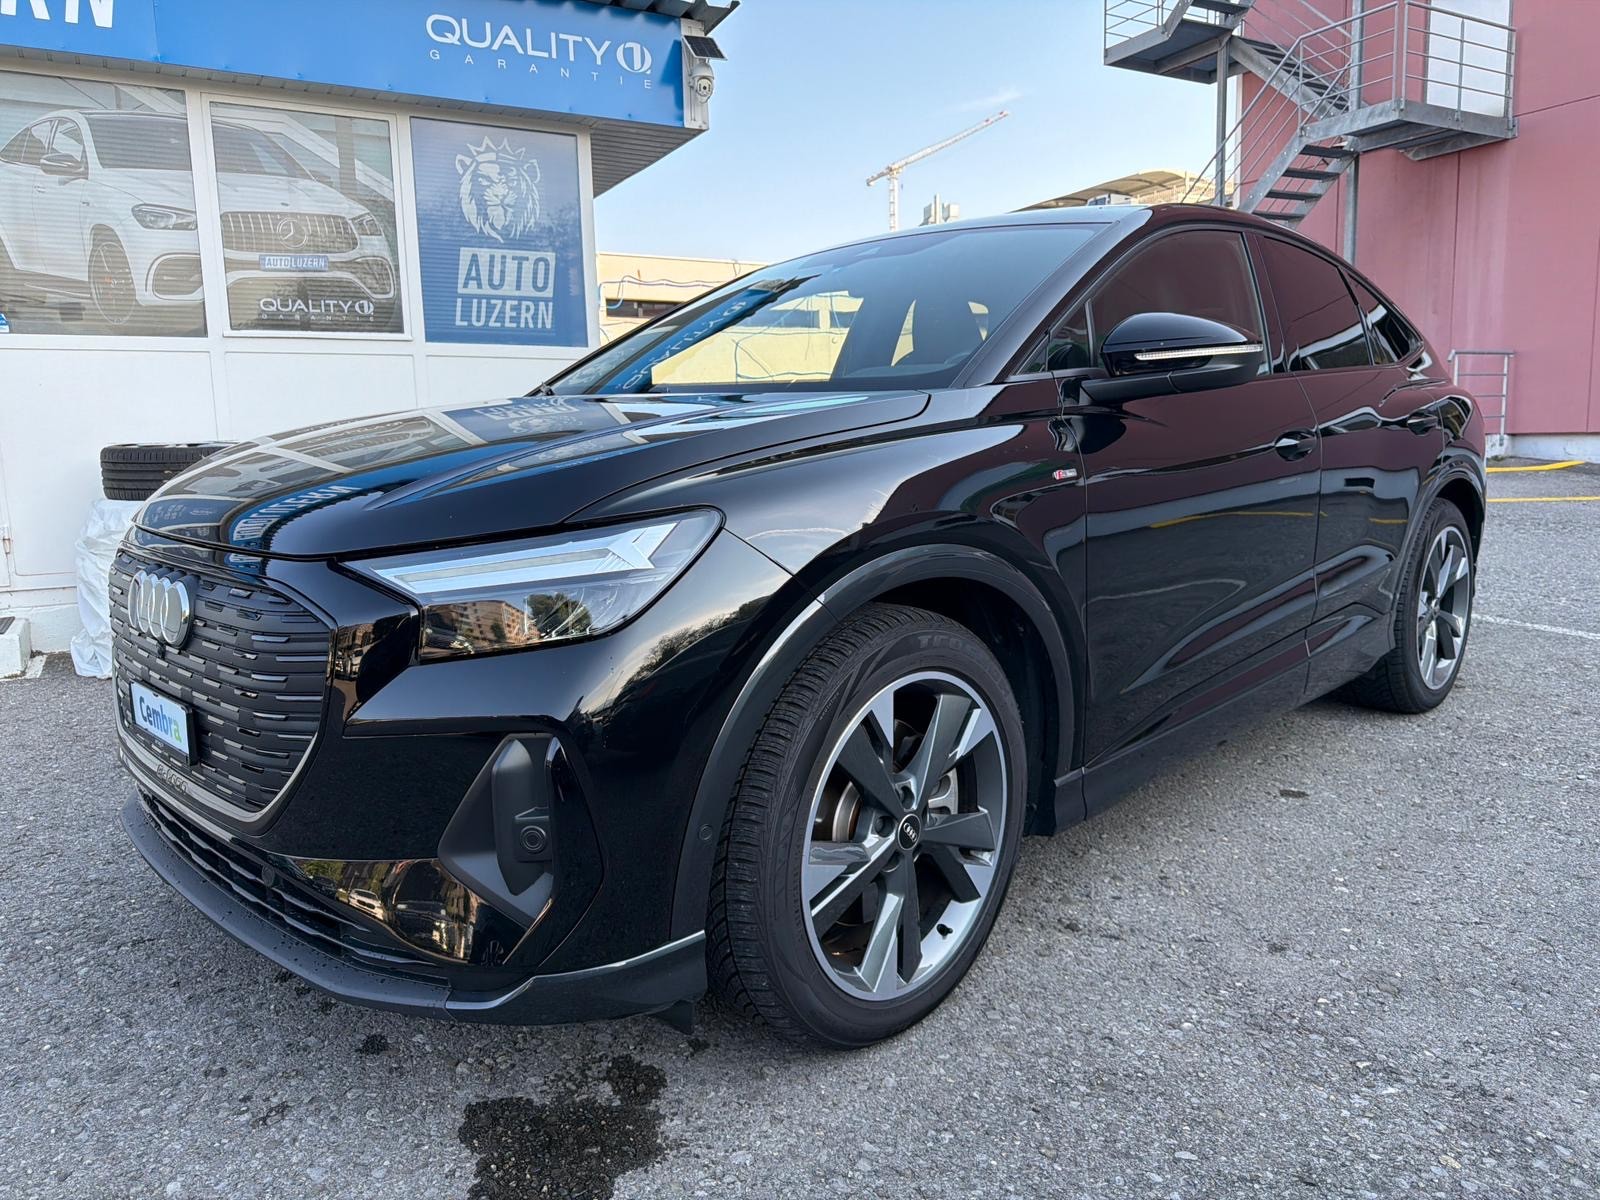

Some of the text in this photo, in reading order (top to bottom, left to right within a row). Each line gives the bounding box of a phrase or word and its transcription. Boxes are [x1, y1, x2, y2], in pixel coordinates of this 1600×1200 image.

[426, 14, 611, 65] QUALITY
[429, 49, 652, 89] GARANTIE
[462, 253, 551, 293] AUTO
[260, 298, 352, 313] QUALITY
[455, 298, 553, 329] LUZERN
[139, 695, 182, 743] Cembra
